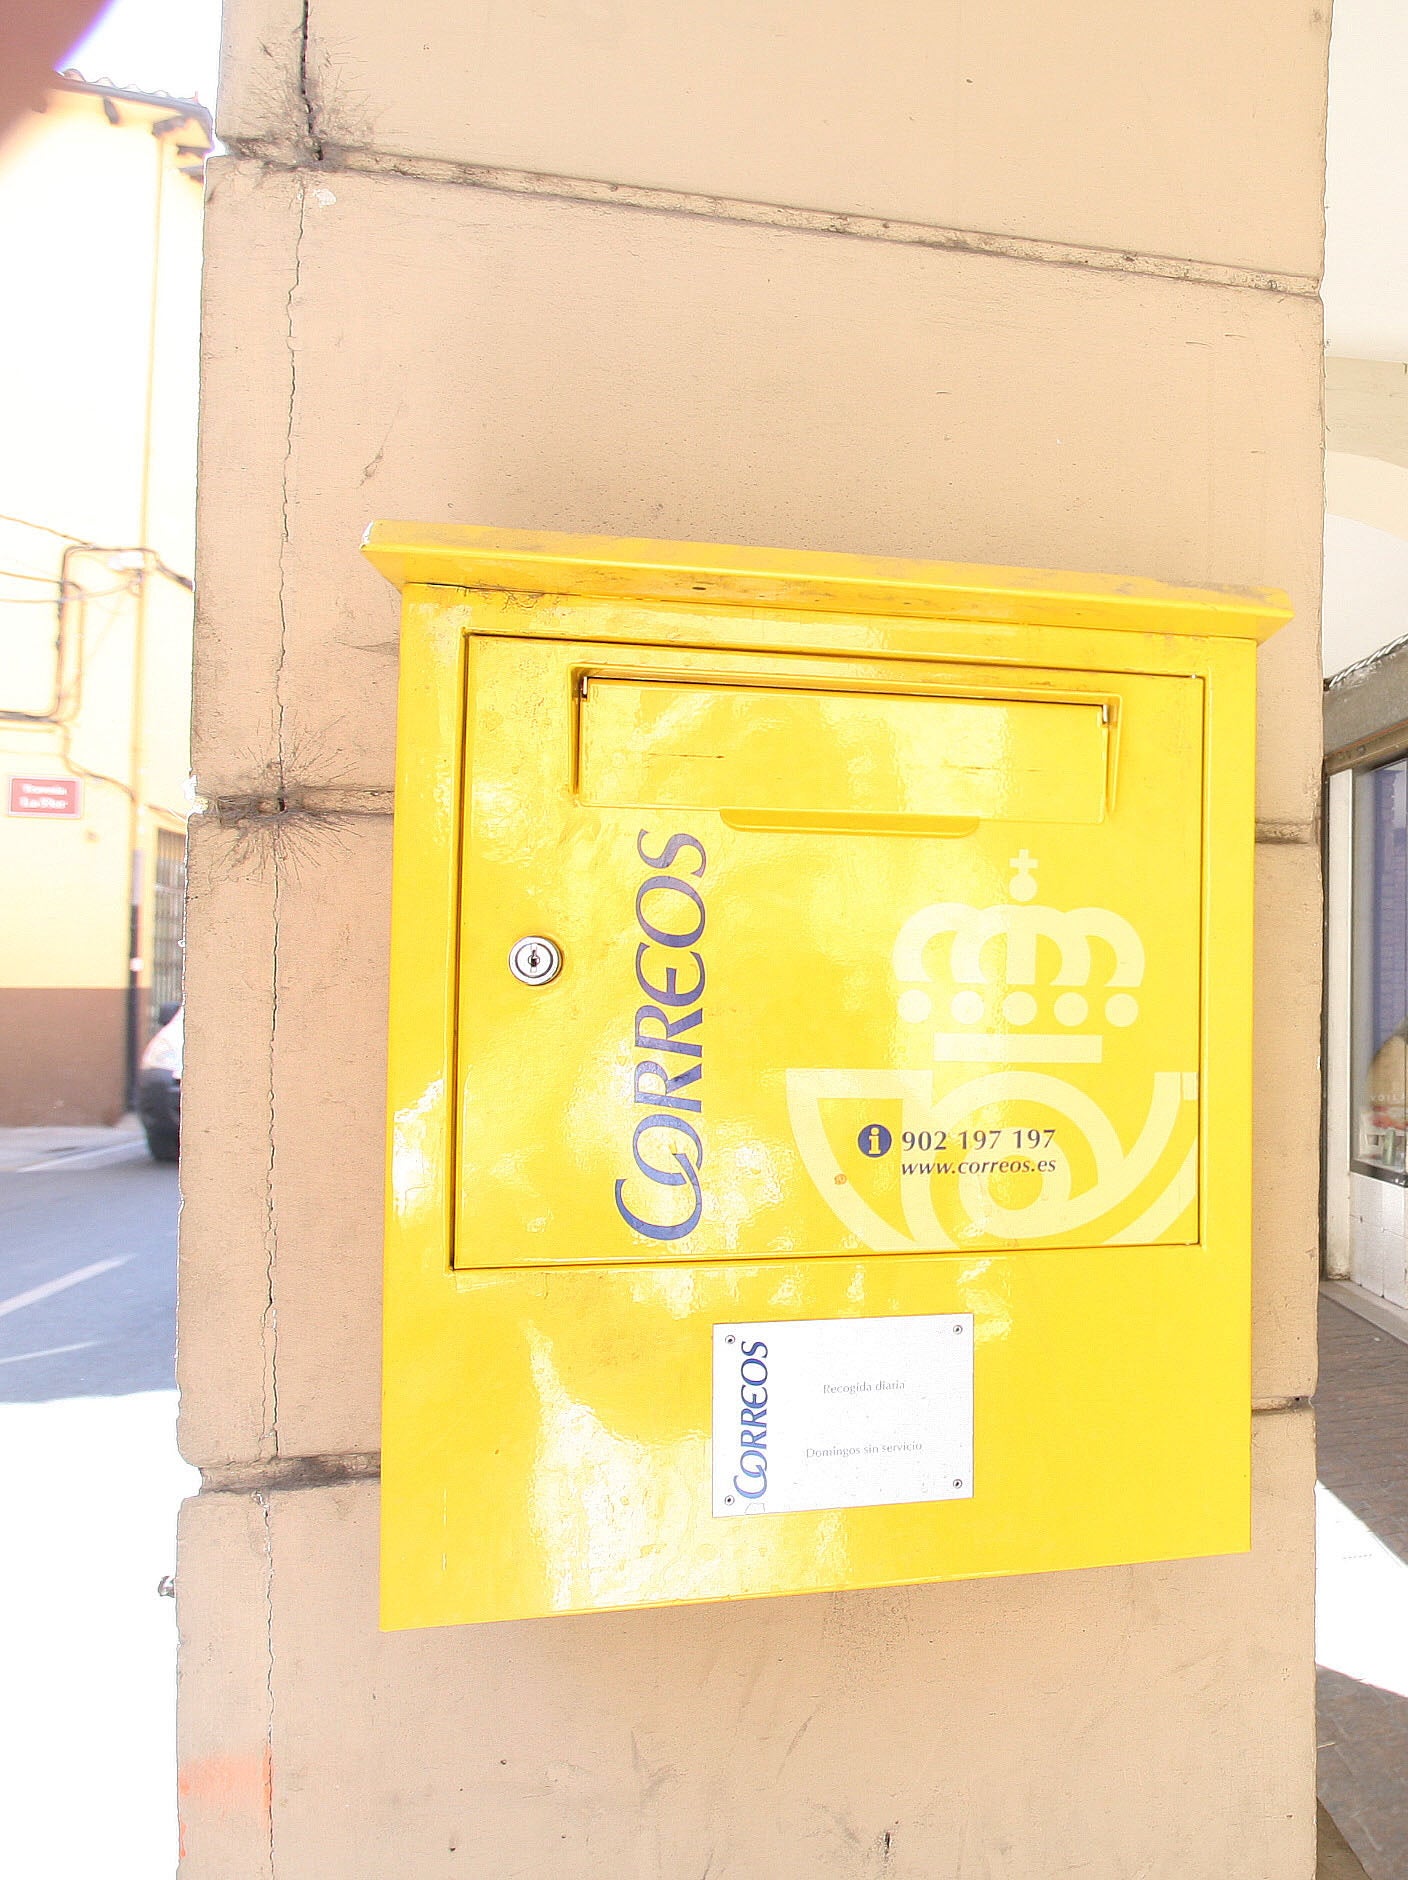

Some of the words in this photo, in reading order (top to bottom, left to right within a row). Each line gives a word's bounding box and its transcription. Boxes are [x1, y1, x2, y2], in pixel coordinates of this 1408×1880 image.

[615, 829, 707, 1241] CORREOS
[902, 1131, 948, 1151] 902
[959, 1129, 1002, 1150] 197
[1014, 1128, 1057, 1150] 197
[901, 1159, 1057, 1176] www.correos.es
[823, 1380, 872, 1397] Recogida
[875, 1379, 905, 1392] diaria
[733, 1340, 769, 1500] CORREOS
[806, 1445, 861, 1459] Domingos
[863, 1444, 879, 1454] sin
[881, 1440, 923, 1452] servicio
